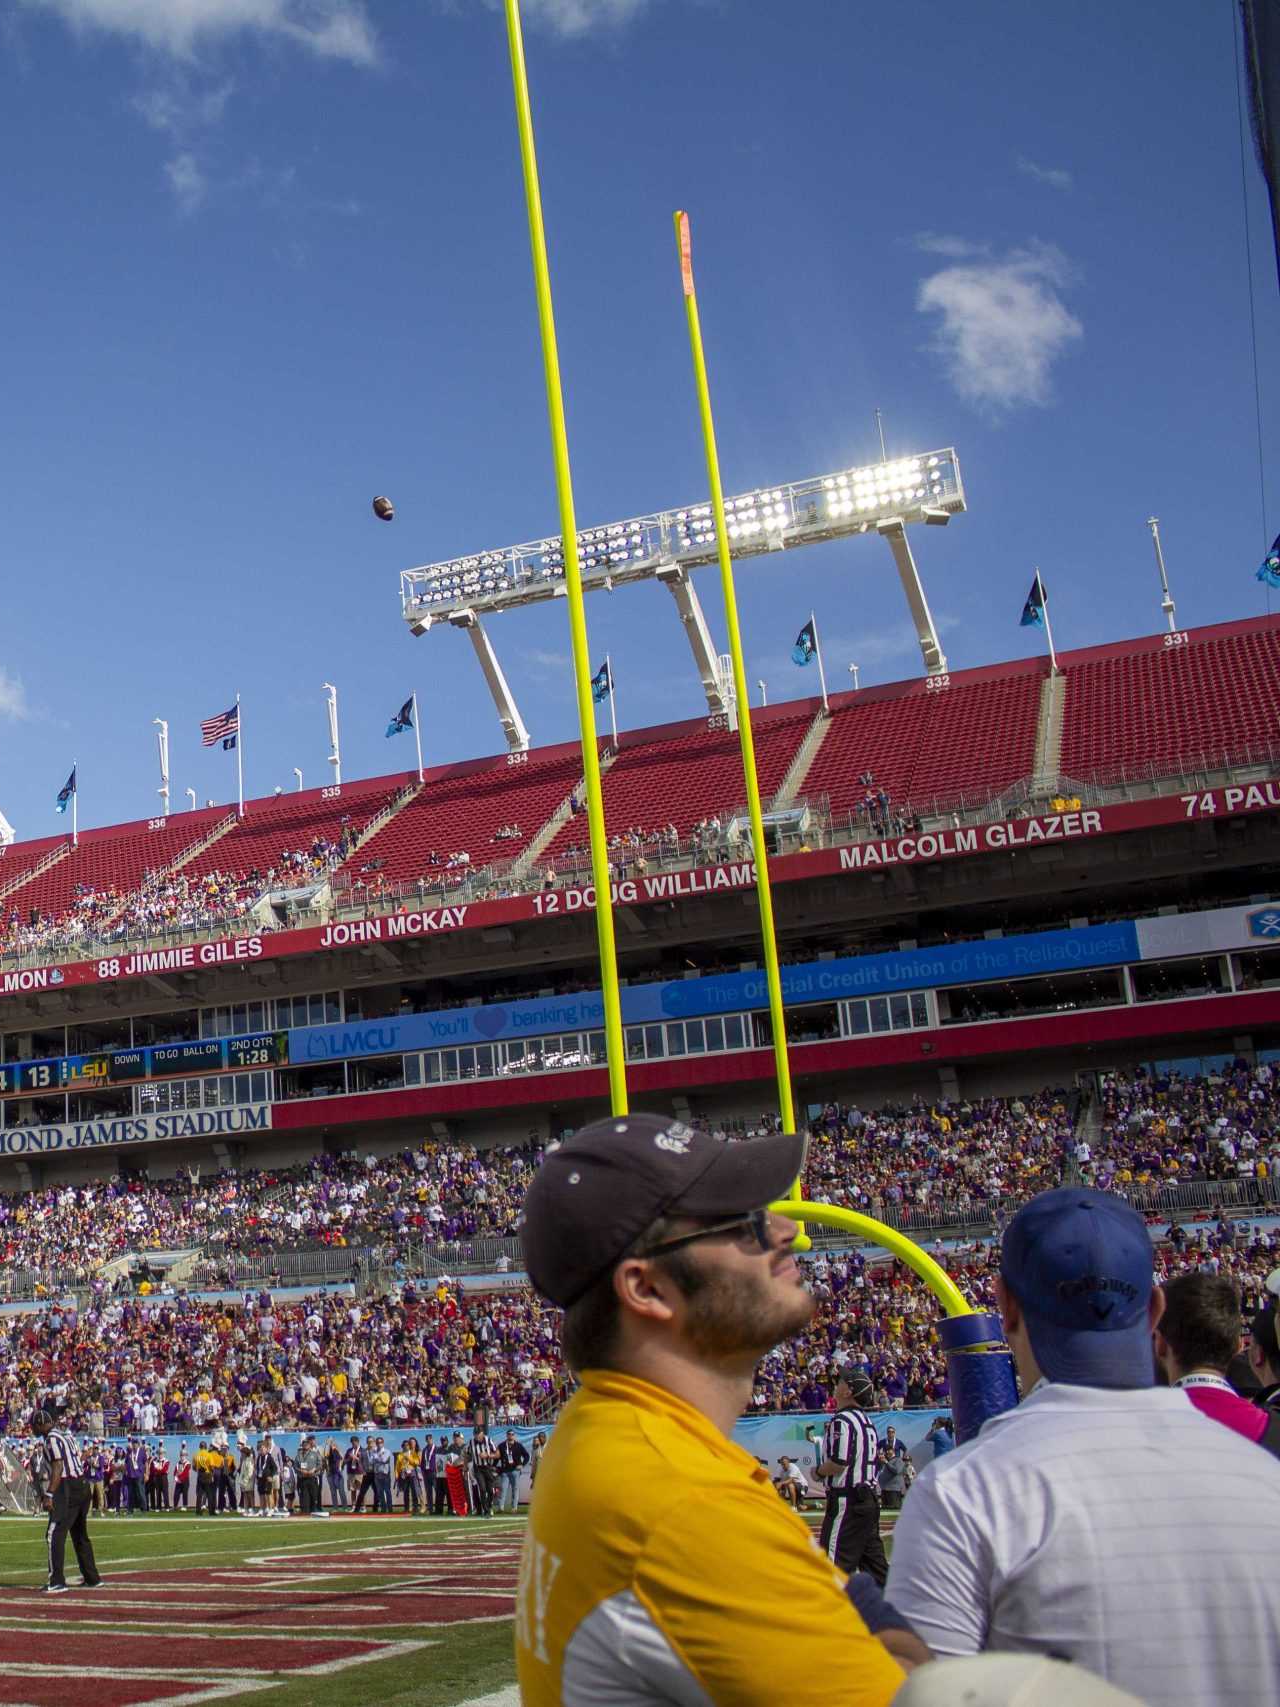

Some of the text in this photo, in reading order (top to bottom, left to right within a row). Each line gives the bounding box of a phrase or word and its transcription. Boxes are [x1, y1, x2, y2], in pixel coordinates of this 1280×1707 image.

[1163, 631, 1189, 646] 331
[925, 674, 951, 689] 332
[506, 751, 529, 766] 334
[320, 785, 342, 799] 335
[1180, 794, 1217, 818] 74
[147, 817, 166, 831] 336
[839, 810, 1102, 870] MALCOLM GLAZER
[532, 893, 559, 915] 12
[320, 906, 469, 947] JOHN MCKAY
[98, 937, 263, 978] 88 JIMMIE GILES
[704, 985, 737, 1002] The
[744, 976, 814, 997] Ofcial
[819, 967, 880, 990] Credit
[884, 960, 944, 981] Union
[951, 954, 971, 974] of
[975, 949, 1009, 969] the
[1014, 936, 1129, 966] ReliaQuest
[428, 1016, 469, 1039] You'll
[512, 1005, 577, 1028] banking
[231, 1036, 273, 1050] 2ND QTR
[330, 1028, 396, 1052] LMCU
[114, 1054, 140, 1065] DOWN
[154, 1049, 178, 1060] TO GO
[183, 1044, 219, 1057] BALL ON
[237, 1050, 269, 1065] 1:28
[28, 1065, 50, 1088] 13
[71, 1062, 108, 1081] LSU
[66, 1118, 148, 1148] JAMES
[155, 1105, 269, 1139] STADIUM
